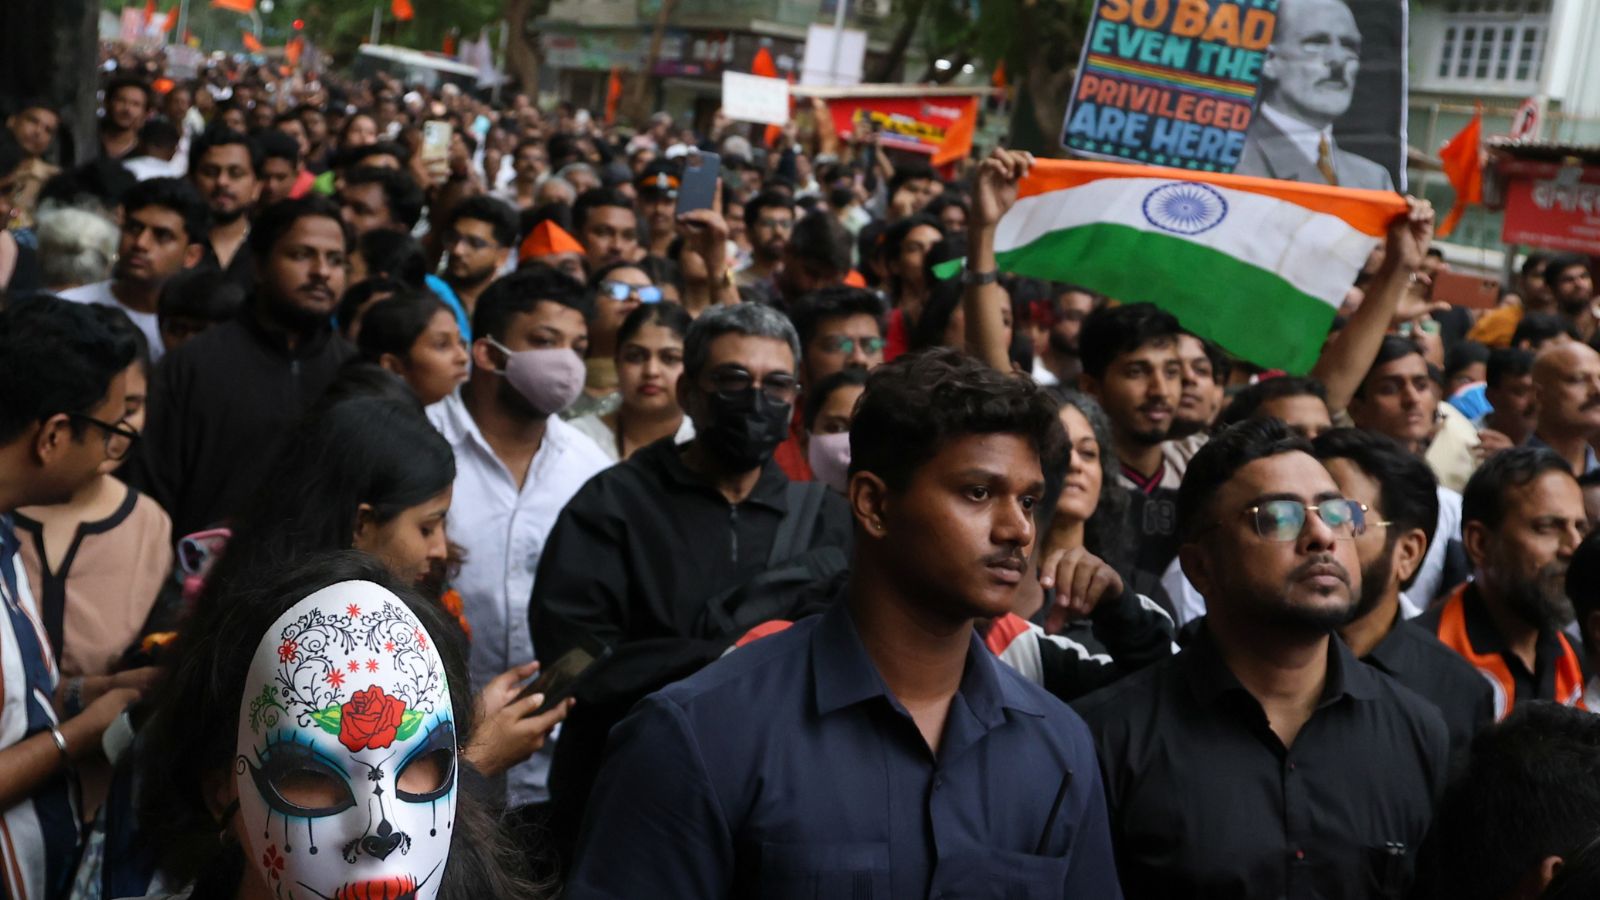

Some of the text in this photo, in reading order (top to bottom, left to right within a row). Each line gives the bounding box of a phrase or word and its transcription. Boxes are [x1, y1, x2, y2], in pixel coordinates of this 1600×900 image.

[1091, 19, 1265, 83] EVEN THE
[1099, 0, 1276, 50] SO BAD
[1067, 101, 1247, 165] ARE HERE
[1078, 75, 1251, 131] PRIVILEGED
